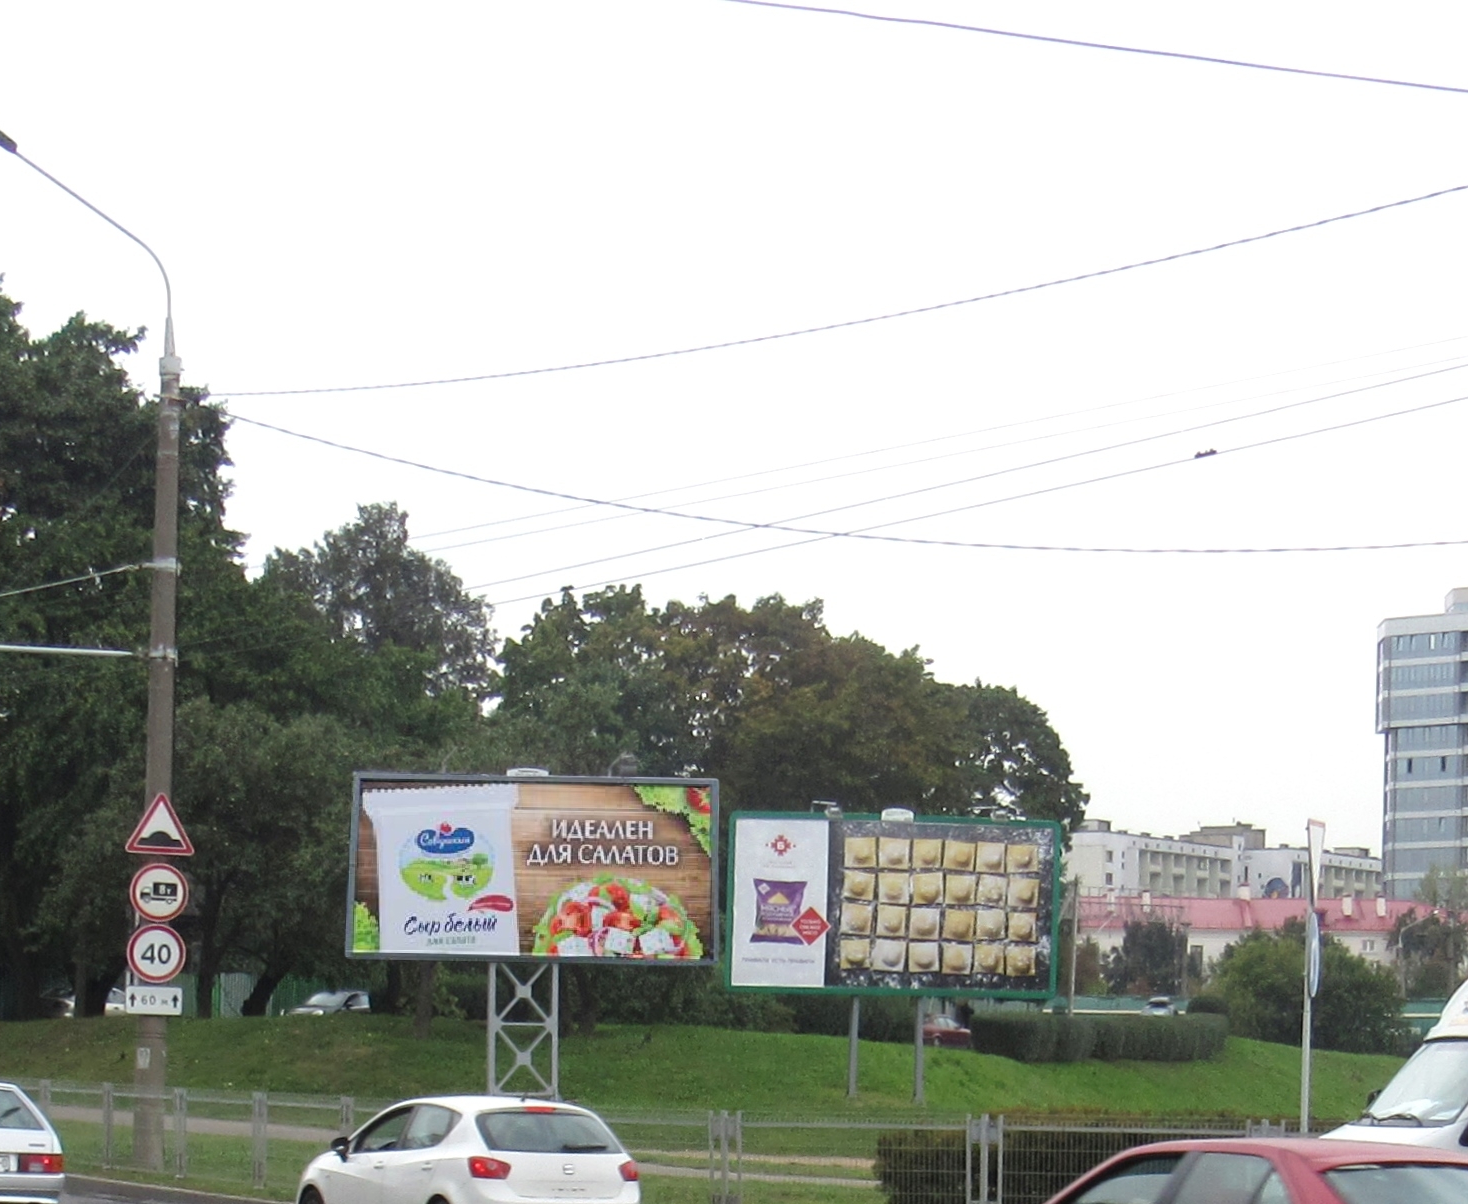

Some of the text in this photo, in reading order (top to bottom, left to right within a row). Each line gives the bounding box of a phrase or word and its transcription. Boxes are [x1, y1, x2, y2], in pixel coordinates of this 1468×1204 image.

[552, 819, 654, 841] ИДЕАЛЕН
[526, 844, 679, 866] ДЛЯ САЛАТОВ
[403, 912, 498, 936] Сыр белый
[141, 943, 172, 965] 40
[141, 995, 157, 1005] 60
